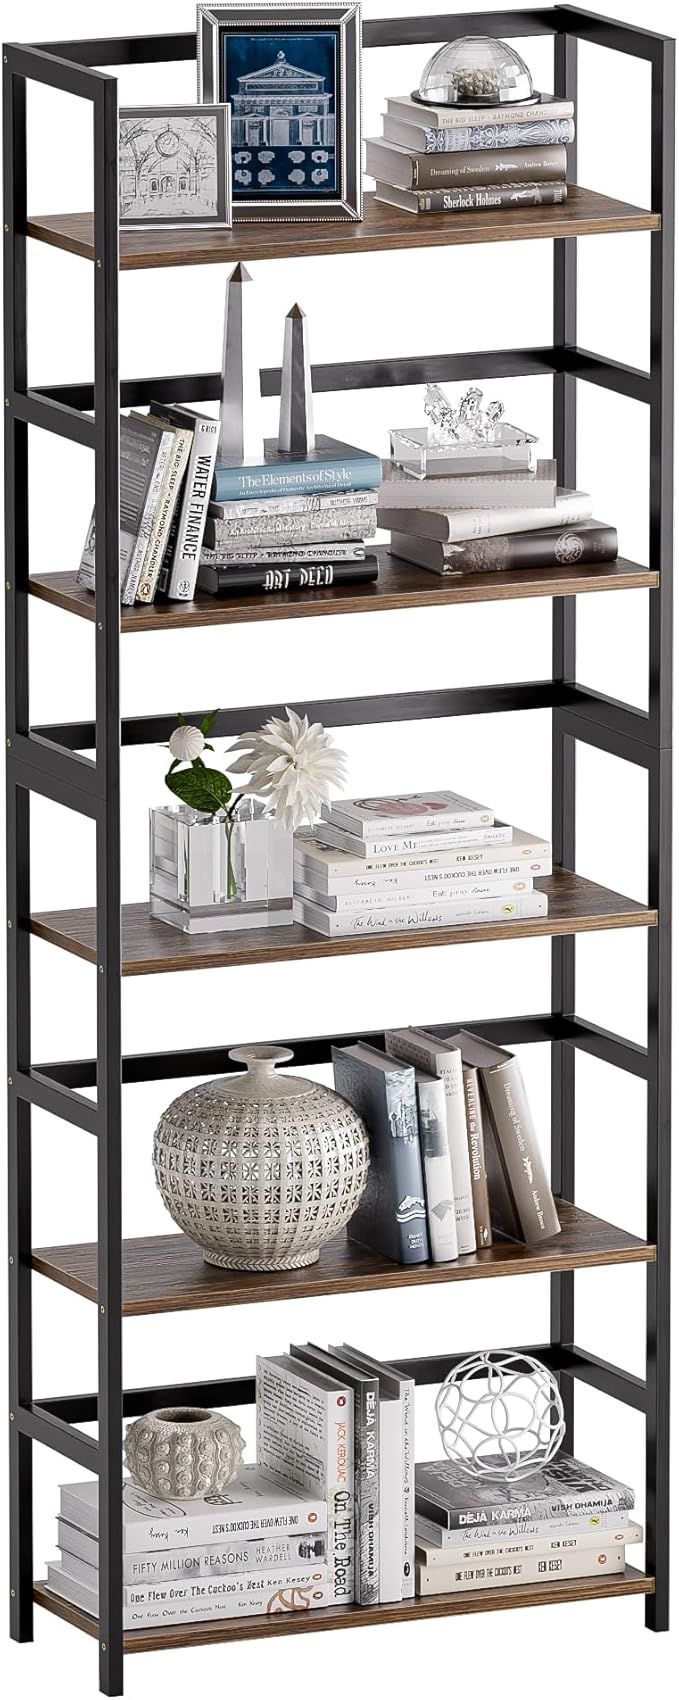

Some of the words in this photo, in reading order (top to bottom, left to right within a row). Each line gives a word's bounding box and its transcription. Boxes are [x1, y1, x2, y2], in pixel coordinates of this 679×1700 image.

[430, 167, 459, 176] Dreaming
[460, 165, 467, 174] of
[466, 164, 490, 173] Sweden
[443, 194, 474, 209] Sherlock
[475, 192, 502, 206] Holmes
[174, 454, 182, 468] BIG
[168, 470, 178, 490] SLEEP
[192, 456, 212, 498] WATER
[239, 475, 262, 488] The
[262, 470, 312, 486] Elements
[312, 468, 325, 482] of
[325, 468, 352, 482] Style
[157, 500, 171, 537] RAYMOND
[182, 502, 204, 560] FINANCE
[148, 540, 161, 578] CHANDLER
[374, 844, 398, 854] LOVE
[403, 840, 418, 850] ME
[408, 910, 442, 924] Willows
[504, 1082, 516, 1117] Dreaming
[514, 1124, 526, 1152] Sweden
[470, 1132, 480, 1180] Revolution
[335, 1422, 346, 1440] JACK
[337, 1444, 346, 1483] KEROUAC
[366, 1430, 376, 1480] KARMA
[334, 1490, 350, 1514] On
[552, 1504, 572, 1512] VISH
[574, 1499, 613, 1509] DHAMIJA
[275, 1516, 288, 1526] FLEW
[289, 1516, 298, 1525] ONE
[491, 1507, 532, 1520] KARMA
[212, 1524, 225, 1534] NEST
[226, 1521, 250, 1532] CUCKOO'S
[250, 1520, 260, 1529] THE
[261, 1518, 274, 1528] OVER
[509, 1522, 538, 1536] Willows
[334, 1518, 351, 1550] The
[256, 1544, 290, 1554] HEATHER
[133, 1562, 157, 1574] FIFTY
[161, 1558, 200, 1572] MILLION
[204, 1551, 248, 1566] REASONS
[256, 1553, 291, 1563] WARDELL
[538, 1561, 546, 1572] KEN
[549, 1559, 562, 1571] KESEY
[334, 1556, 351, 1598] Road
[130, 1593, 144, 1603] One
[148, 1590, 166, 1600] Flew
[169, 1588, 188, 1598] Over
[191, 1586, 205, 1596] The
[208, 1581, 243, 1594] Cuckoo's
[247, 1580, 264, 1590] Nest
